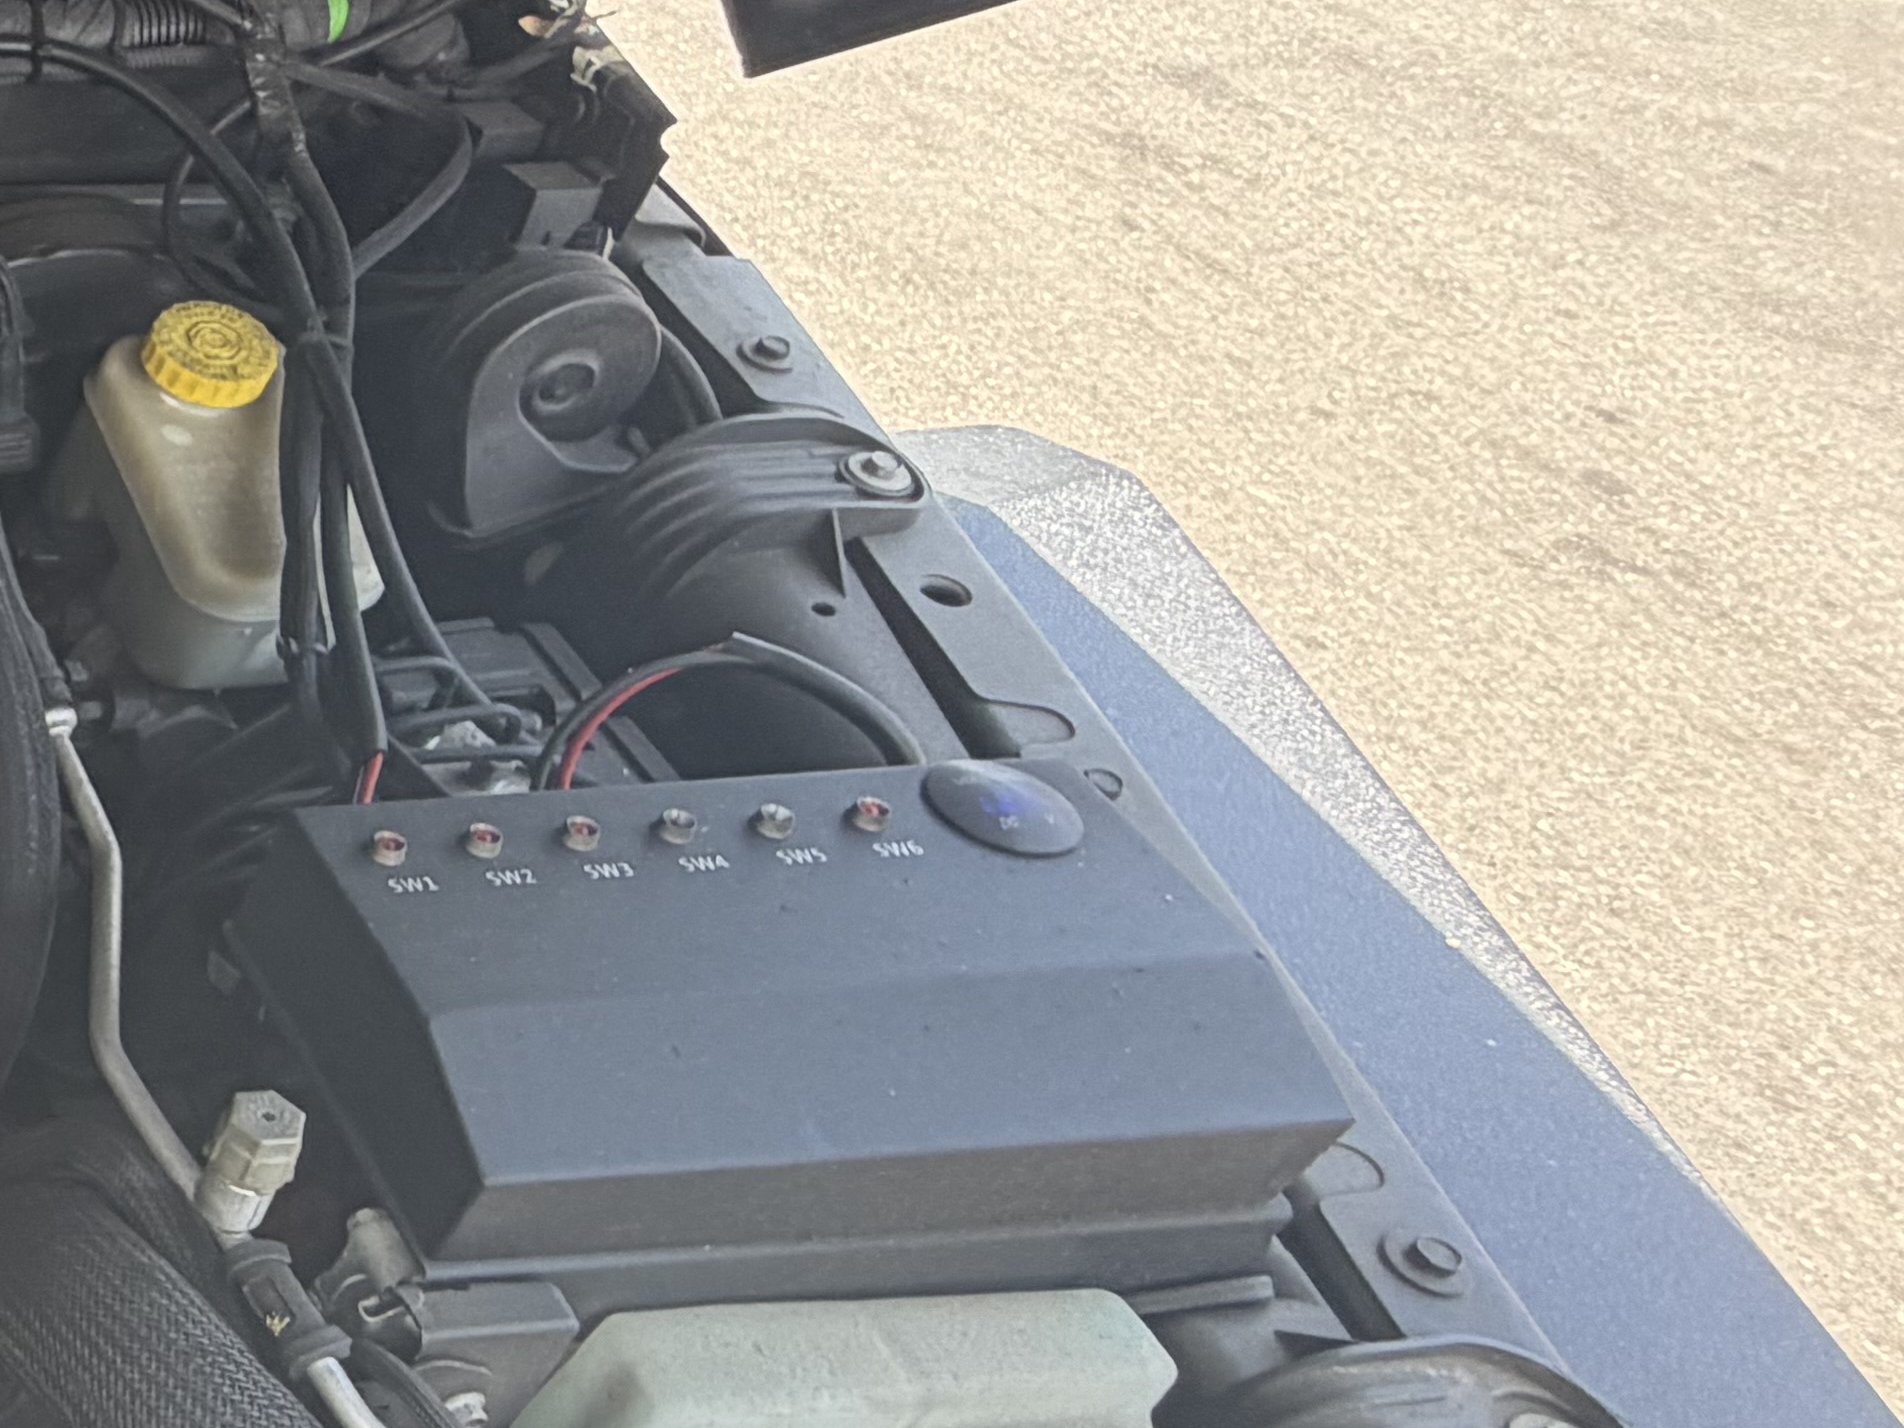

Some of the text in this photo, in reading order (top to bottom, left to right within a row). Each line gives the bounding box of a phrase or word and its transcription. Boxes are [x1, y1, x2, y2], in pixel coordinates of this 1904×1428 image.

[388, 839, 924, 895] SW1 SW2 SW3 SW4 SW5 SW6
